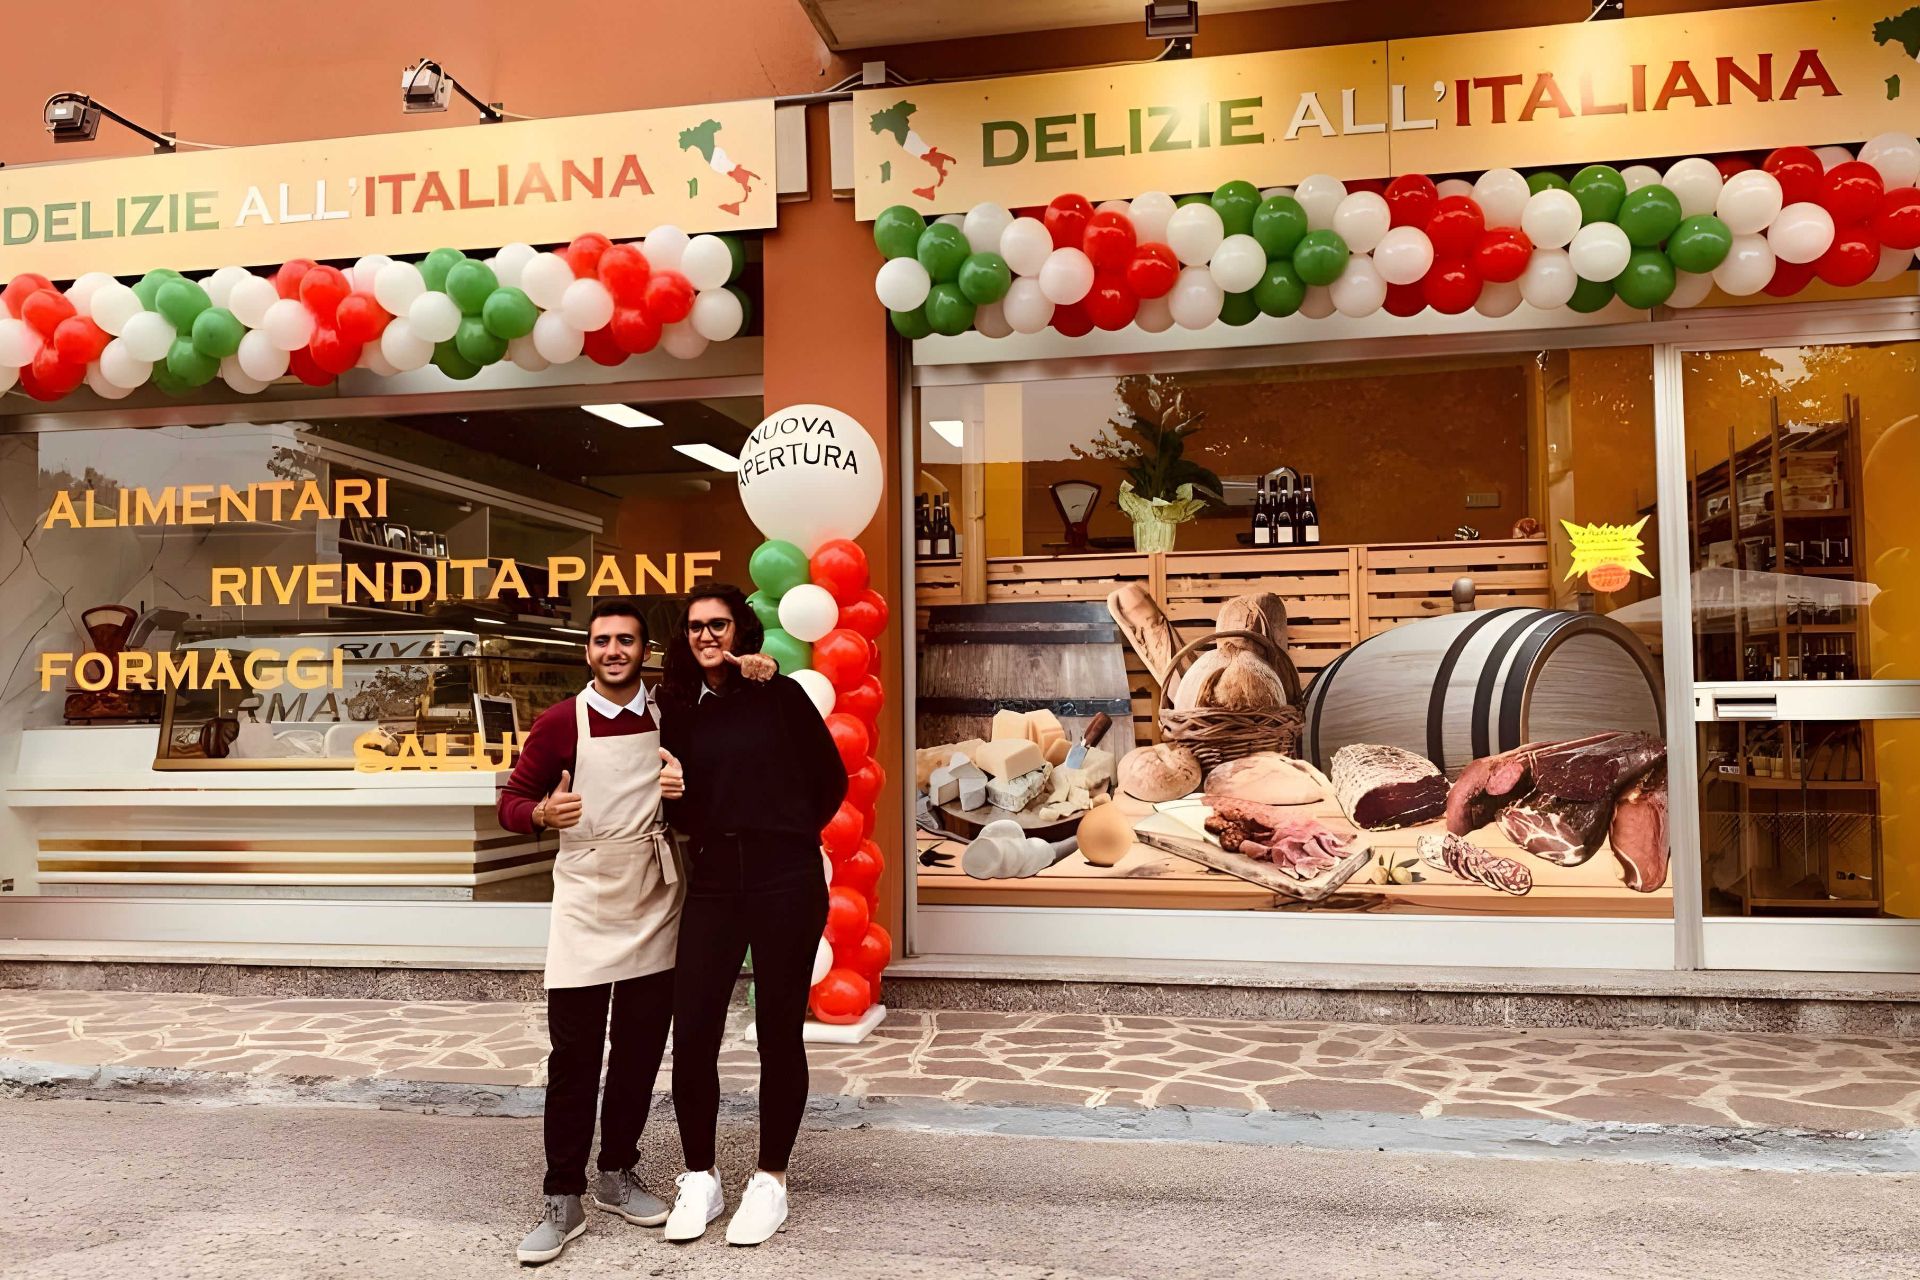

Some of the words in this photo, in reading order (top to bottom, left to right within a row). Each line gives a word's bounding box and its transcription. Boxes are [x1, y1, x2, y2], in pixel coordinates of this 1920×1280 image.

[982, 95, 1265, 168] DELIZIE
[1284, 48, 1843, 141] ALL'ITALIANA
[3, 190, 220, 246] DELIZIE
[234, 154, 655, 228] ALL'ITALIANA
[748, 416, 836, 453] NUOVA
[43, 477, 390, 530] ALIMENTARI
[209, 557, 530, 607] RIVENDITA
[38, 647, 345, 693] FORMAGGI
[353, 730, 532, 774] SALU
